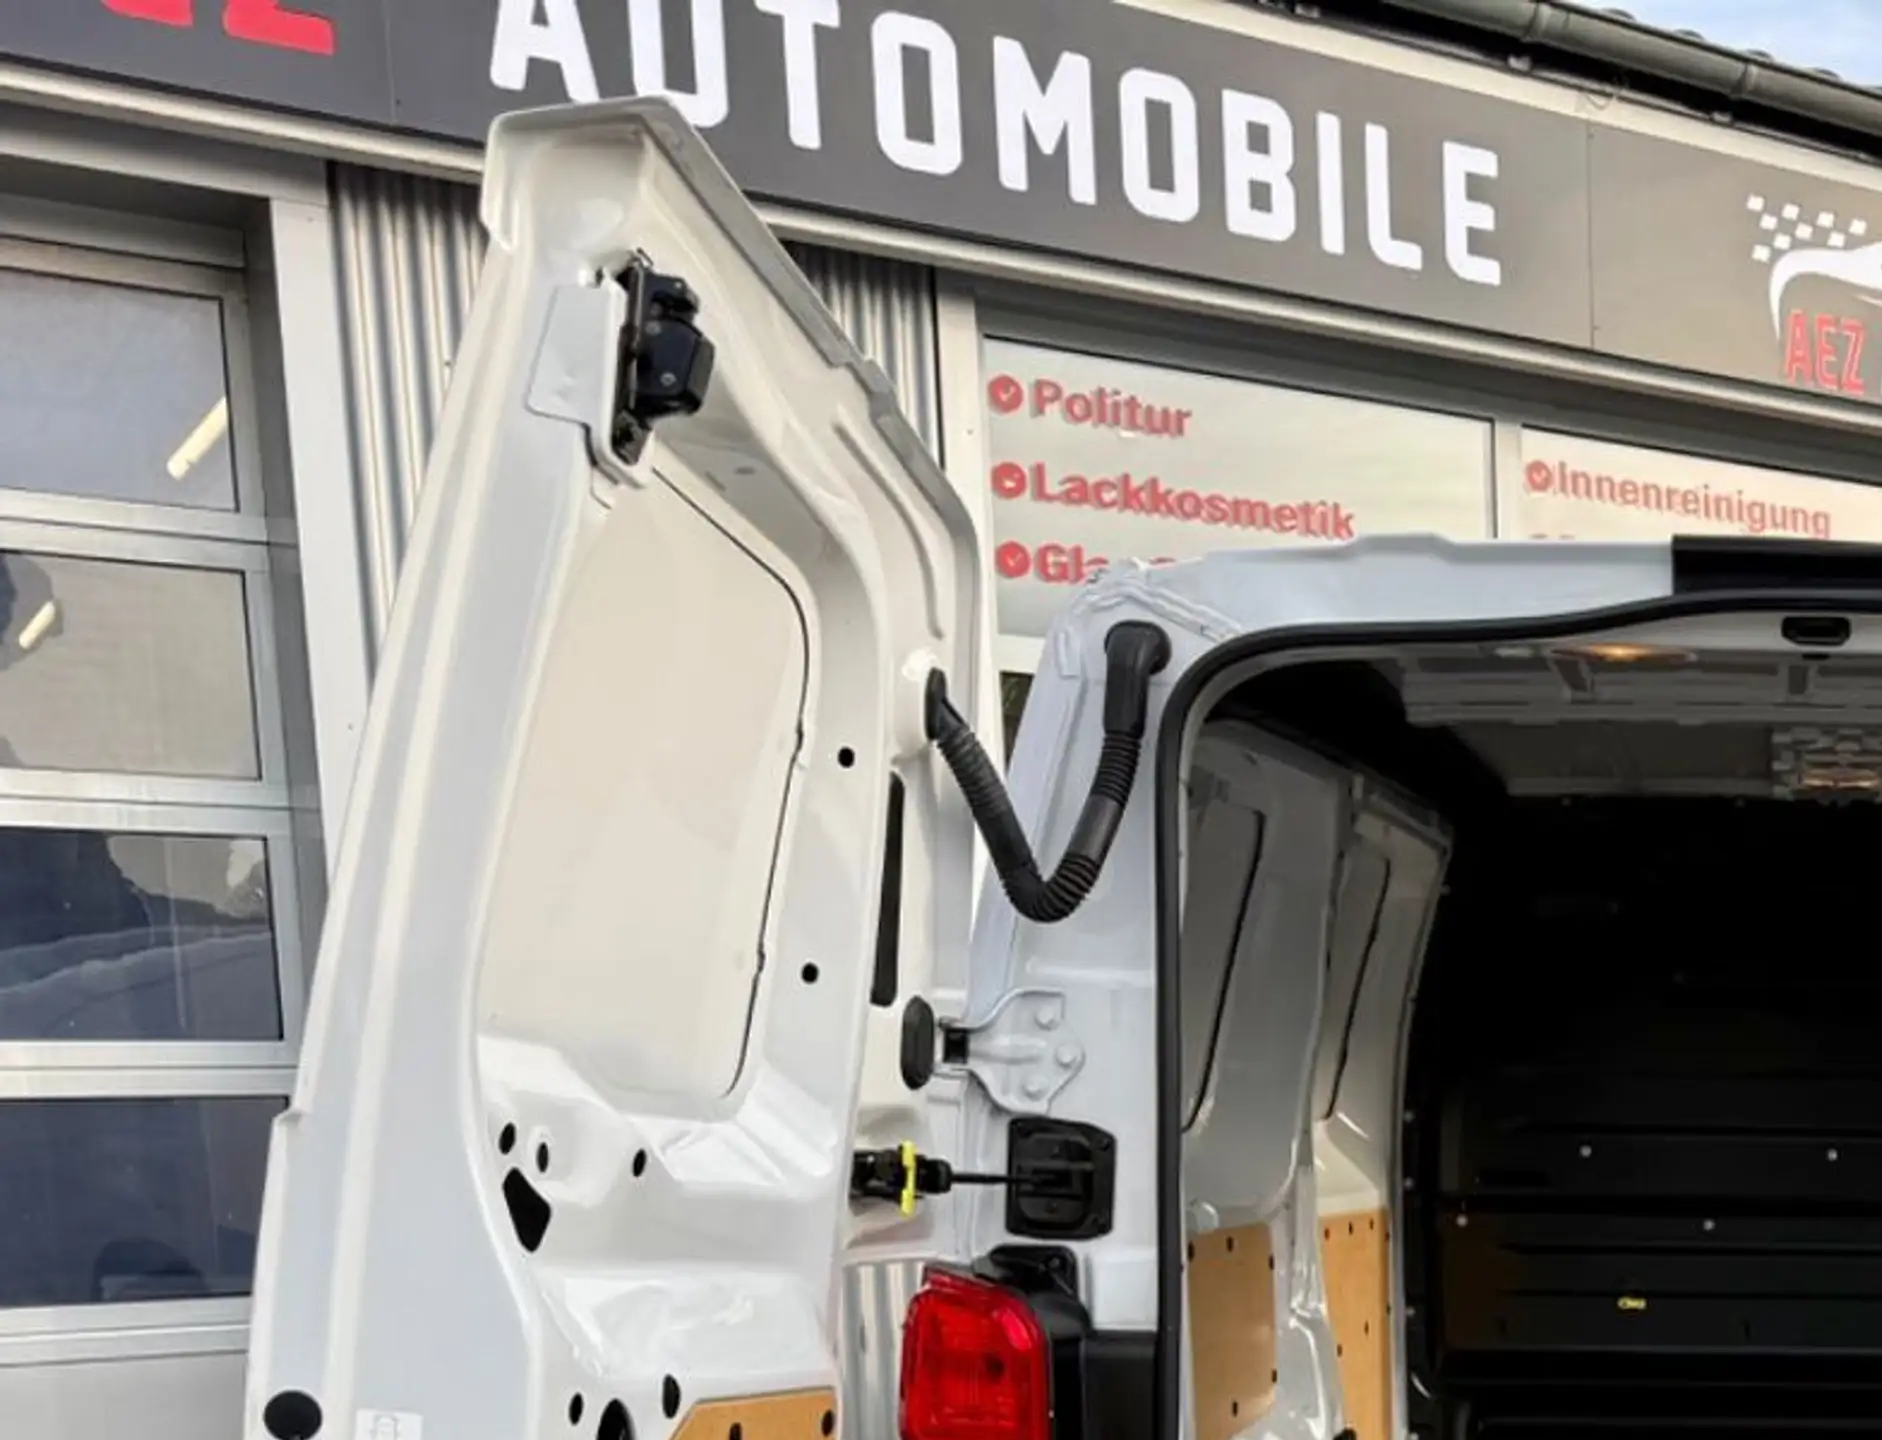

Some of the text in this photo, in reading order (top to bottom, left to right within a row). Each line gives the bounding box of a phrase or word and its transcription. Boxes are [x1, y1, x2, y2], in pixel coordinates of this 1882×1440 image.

[490, 0, 1501, 286] AUTOMOBILE
[1785, 309, 1864, 395] AEZ
[1031, 378, 1192, 437] Politur
[1031, 461, 1355, 542] Lackkosmetik
[1556, 461, 1831, 539] Innenreinigung
